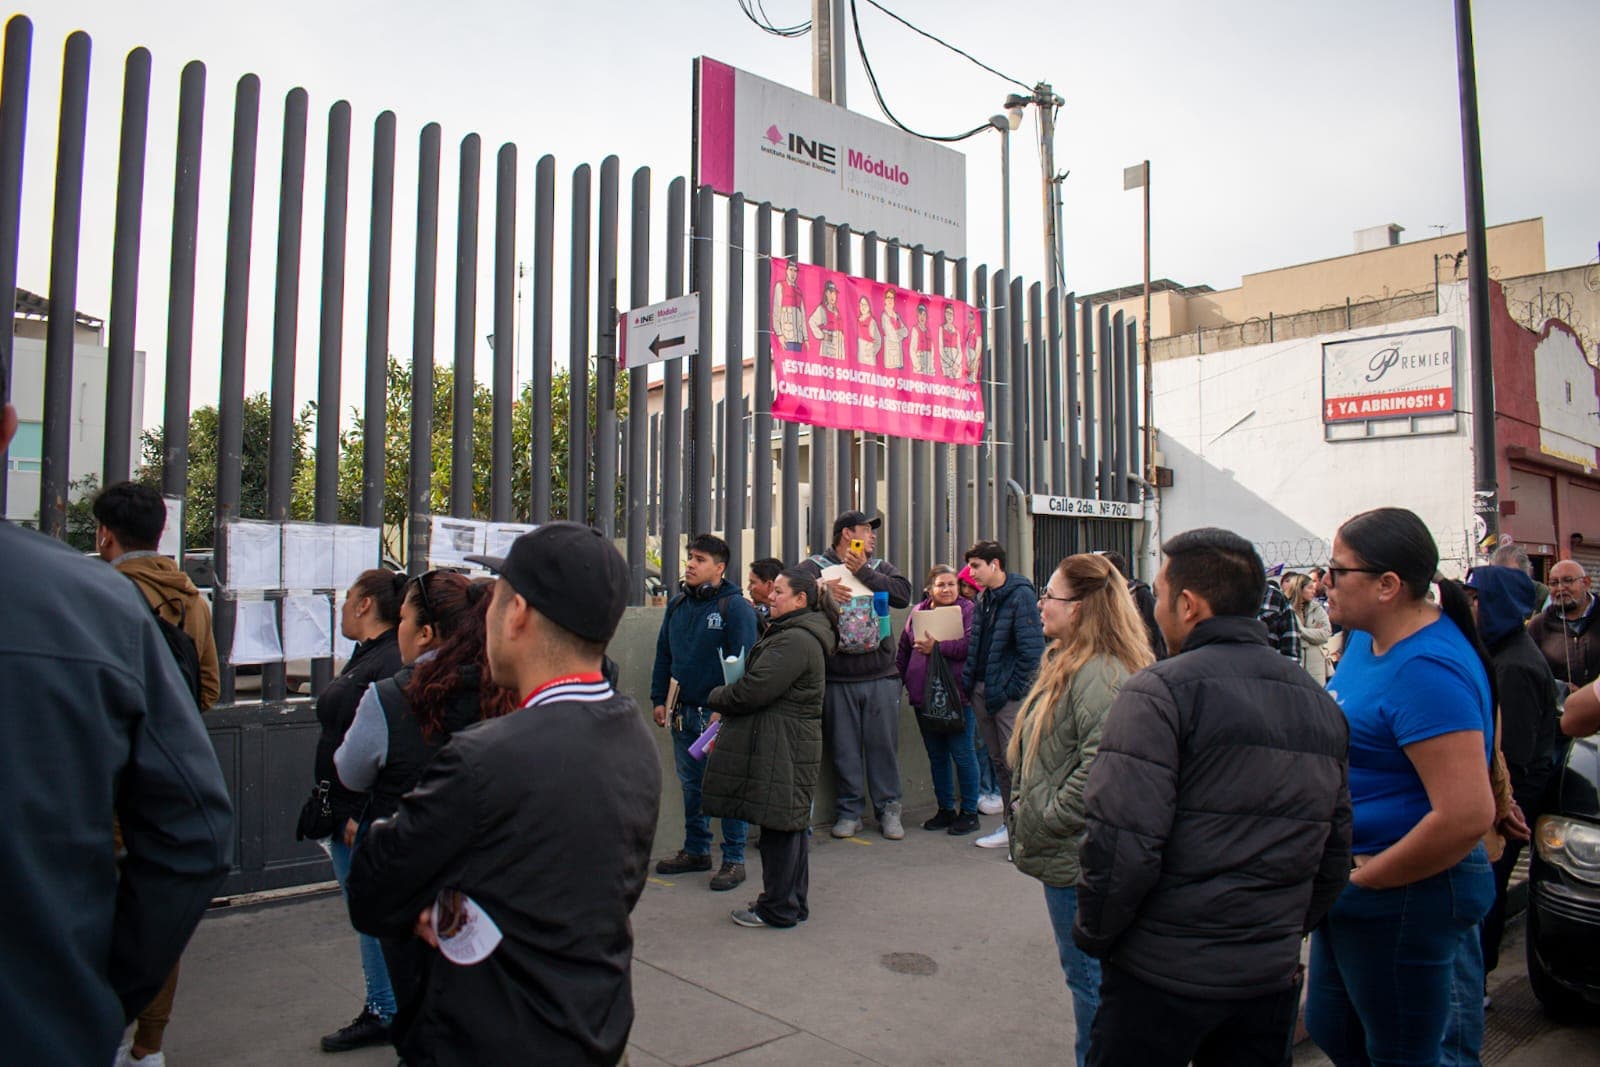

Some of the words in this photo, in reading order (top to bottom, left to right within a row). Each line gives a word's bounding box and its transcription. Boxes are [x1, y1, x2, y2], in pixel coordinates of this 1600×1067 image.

[788, 133, 836, 166] INE
[786, 153, 811, 168] Nacional
[812, 162, 836, 175] Electoral
[848, 148, 909, 185] Módulo
[847, 187, 885, 204] INSTITUTO
[888, 200, 921, 216] NACIONAL
[924, 211, 961, 228] ELECTORAL
[640, 313, 655, 324] INE
[836, 367, 895, 389] SOLICITANDO
[1339, 401, 1357, 414] YA
[1361, 395, 1433, 413] ABRIMOS!!
[1049, 498, 1073, 512] Calle
[1112, 503, 1127, 516] 762
